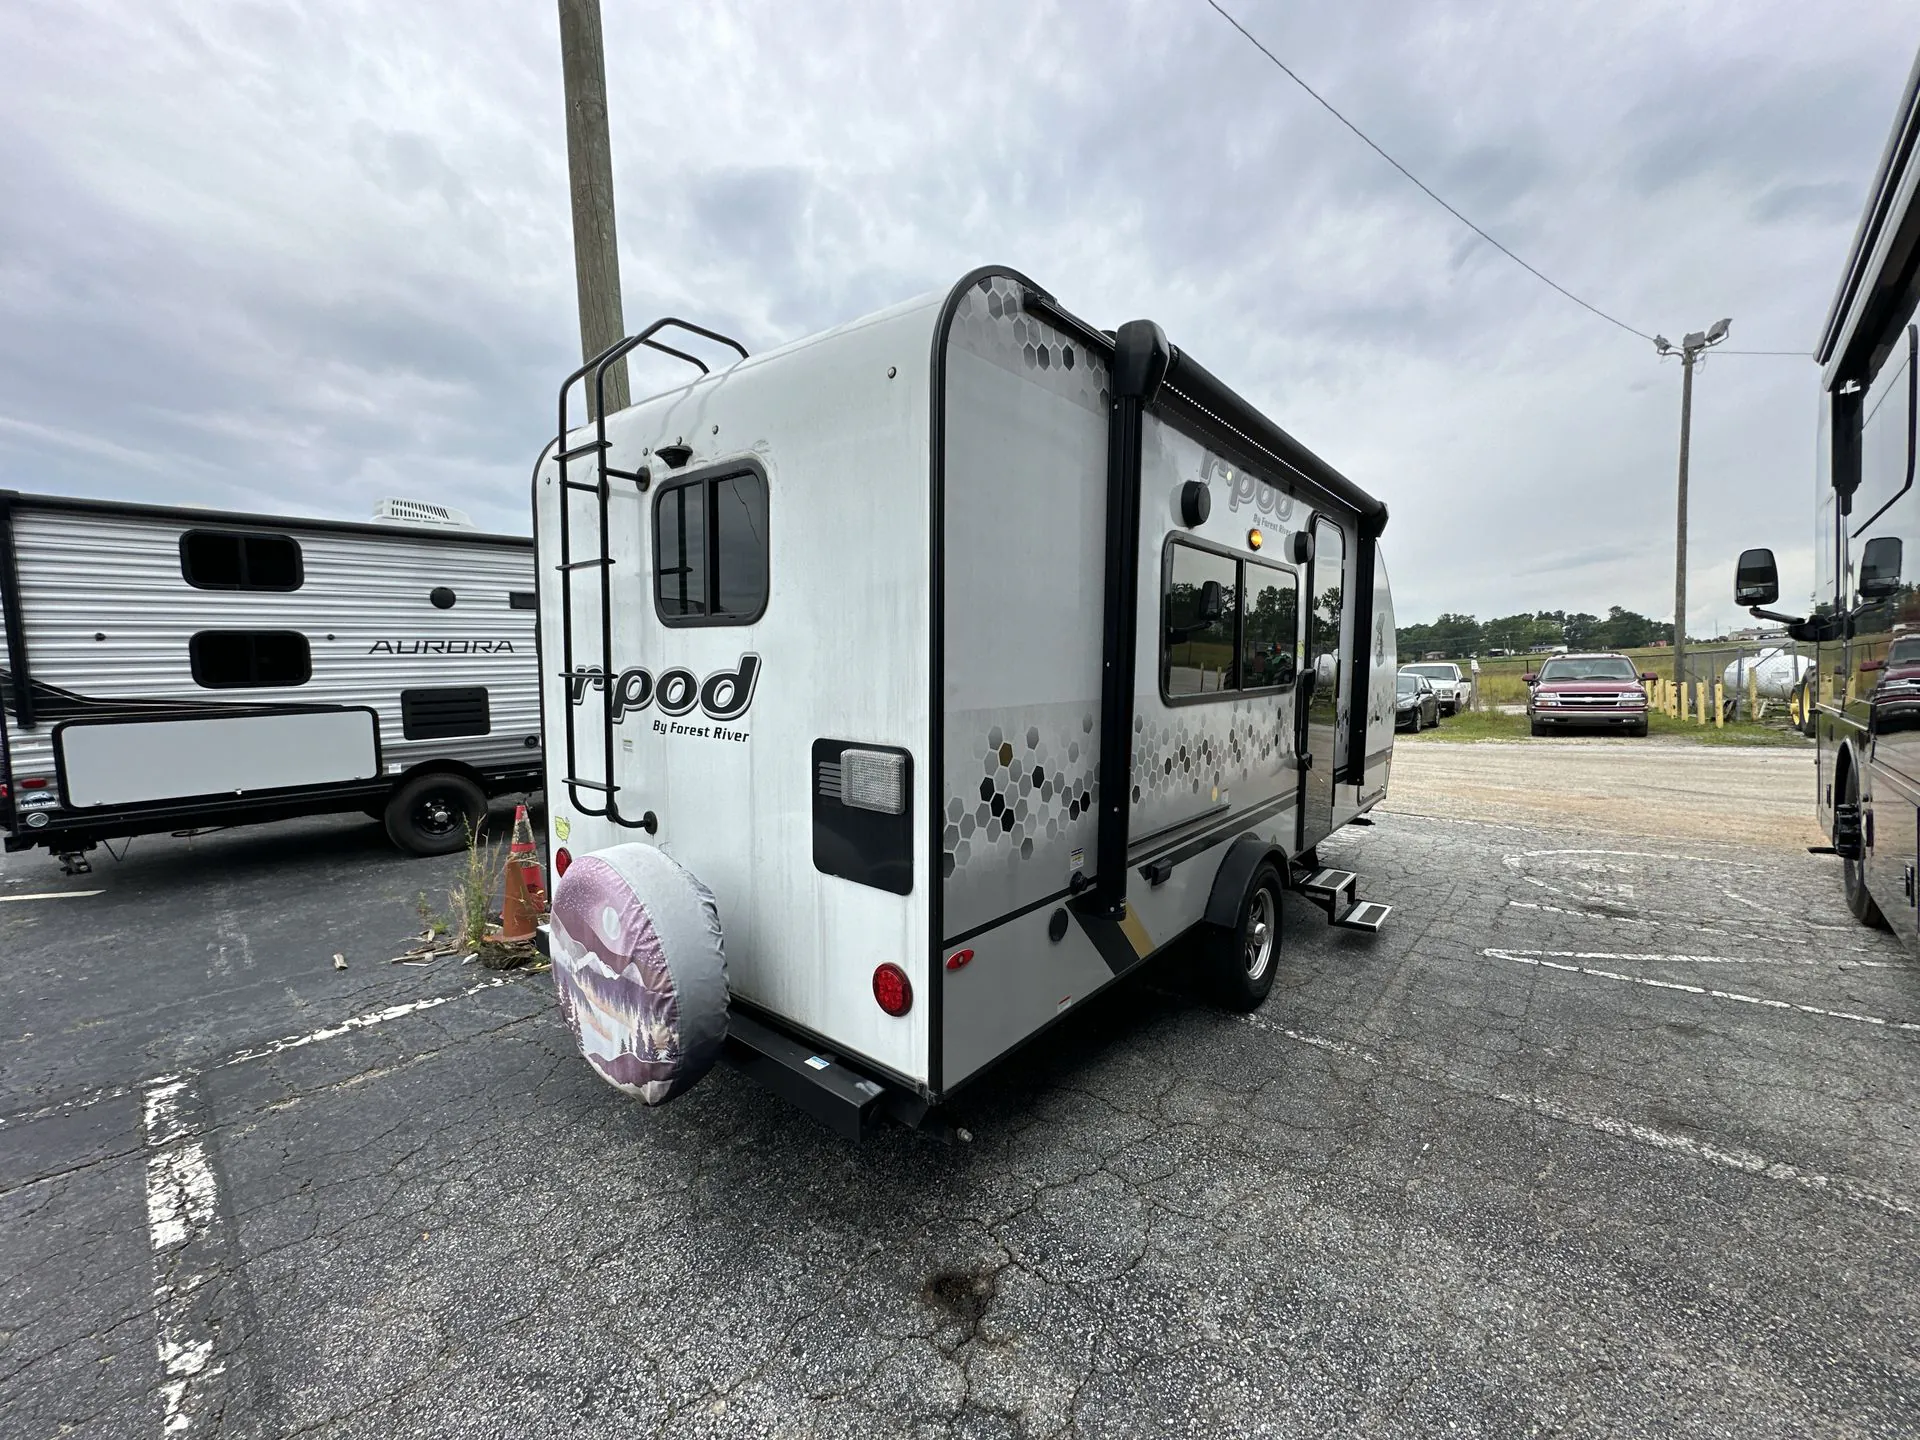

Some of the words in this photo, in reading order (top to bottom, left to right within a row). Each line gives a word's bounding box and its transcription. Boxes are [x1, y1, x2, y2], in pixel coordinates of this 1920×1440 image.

[1253, 513, 1261, 526] By
[1261, 516, 1279, 533] Forest
[368, 640, 515, 655] AURORA
[653, 719, 668, 735] By
[669, 721, 711, 738] Forest
[713, 726, 750, 743] River
